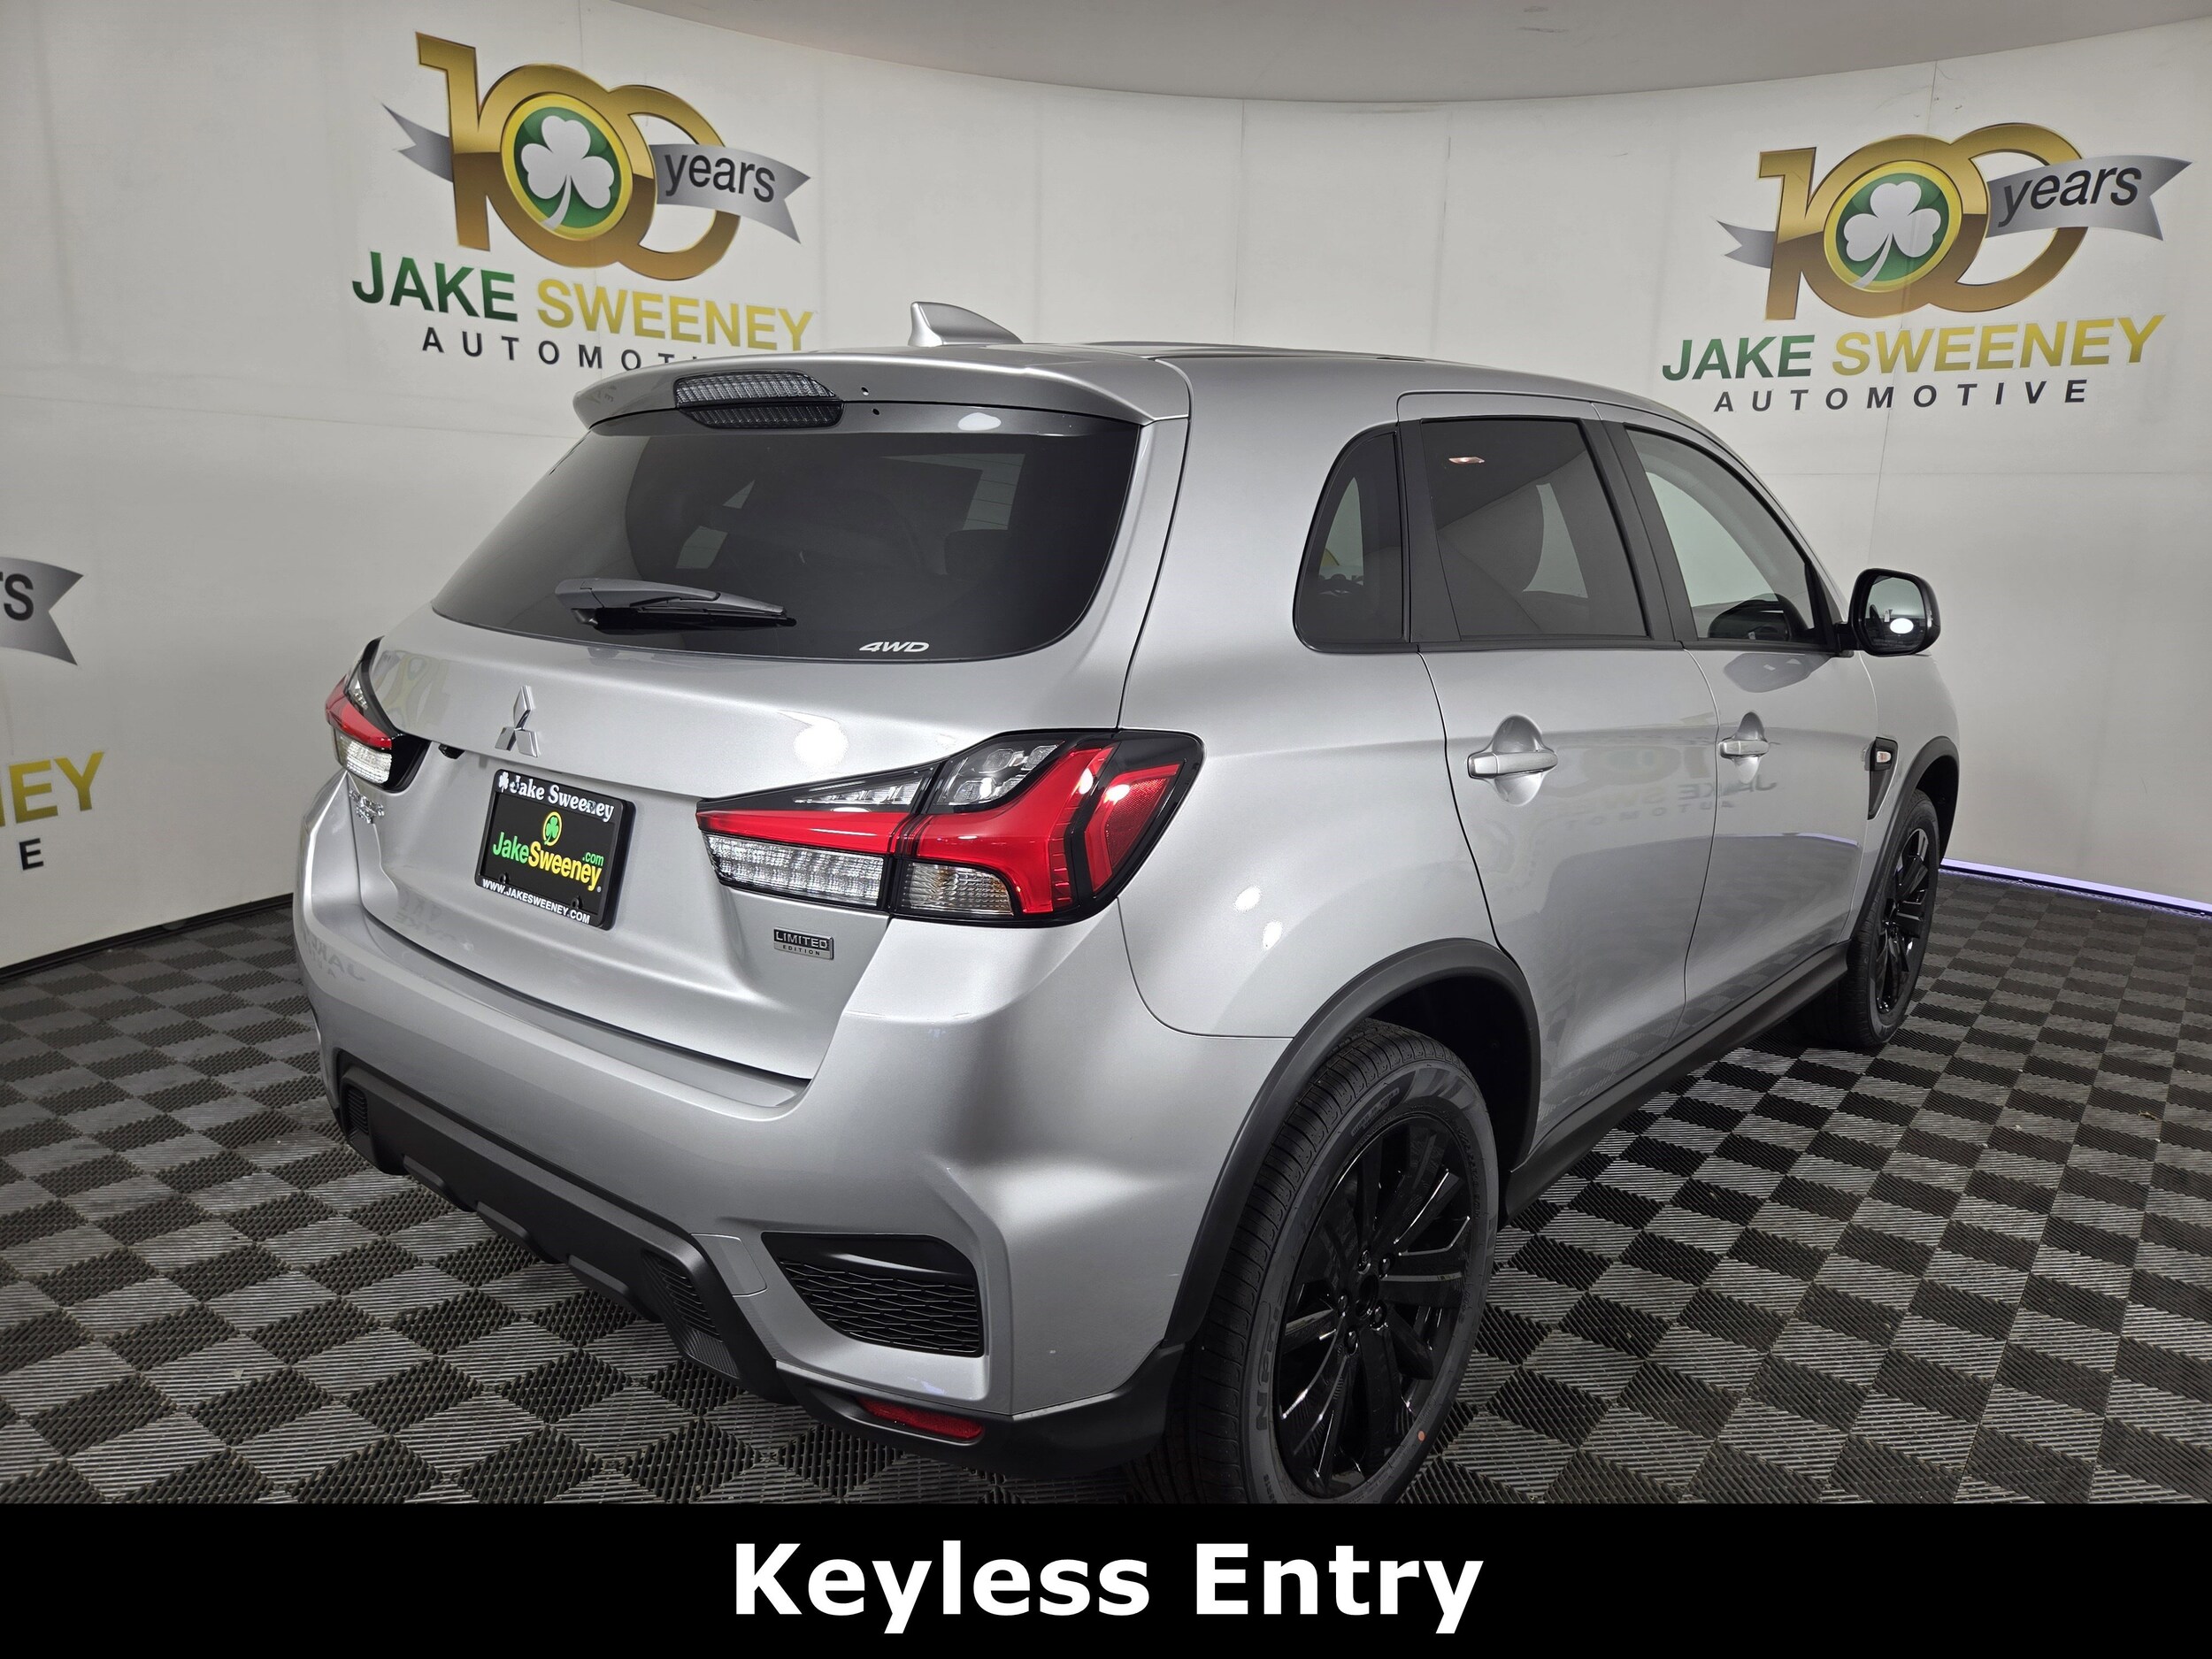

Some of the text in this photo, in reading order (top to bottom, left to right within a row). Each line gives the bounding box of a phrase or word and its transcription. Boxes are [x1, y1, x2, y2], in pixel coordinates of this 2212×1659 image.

[415, 31, 741, 280] 100
[664, 152, 776, 204] years
[1759, 122, 2088, 320] 100
[1997, 166, 2141, 227] years
[352, 250, 813, 351] JAKE SWEENEY
[422, 326, 696, 372] AUTOMOT
[1663, 314, 2166, 381] JAKE SWEENEY
[1714, 379, 2088, 412] AUTOMOTIVE
[858, 641, 930, 652] 4WD
[0, 750, 105, 827] EY
[510, 774, 615, 823] Jake Sweeney
[482, 878, 591, 925] WWW.JAKESWEENEY.COM
[775, 930, 828, 949] LIMITED
[782, 944, 820, 956] EDITION
